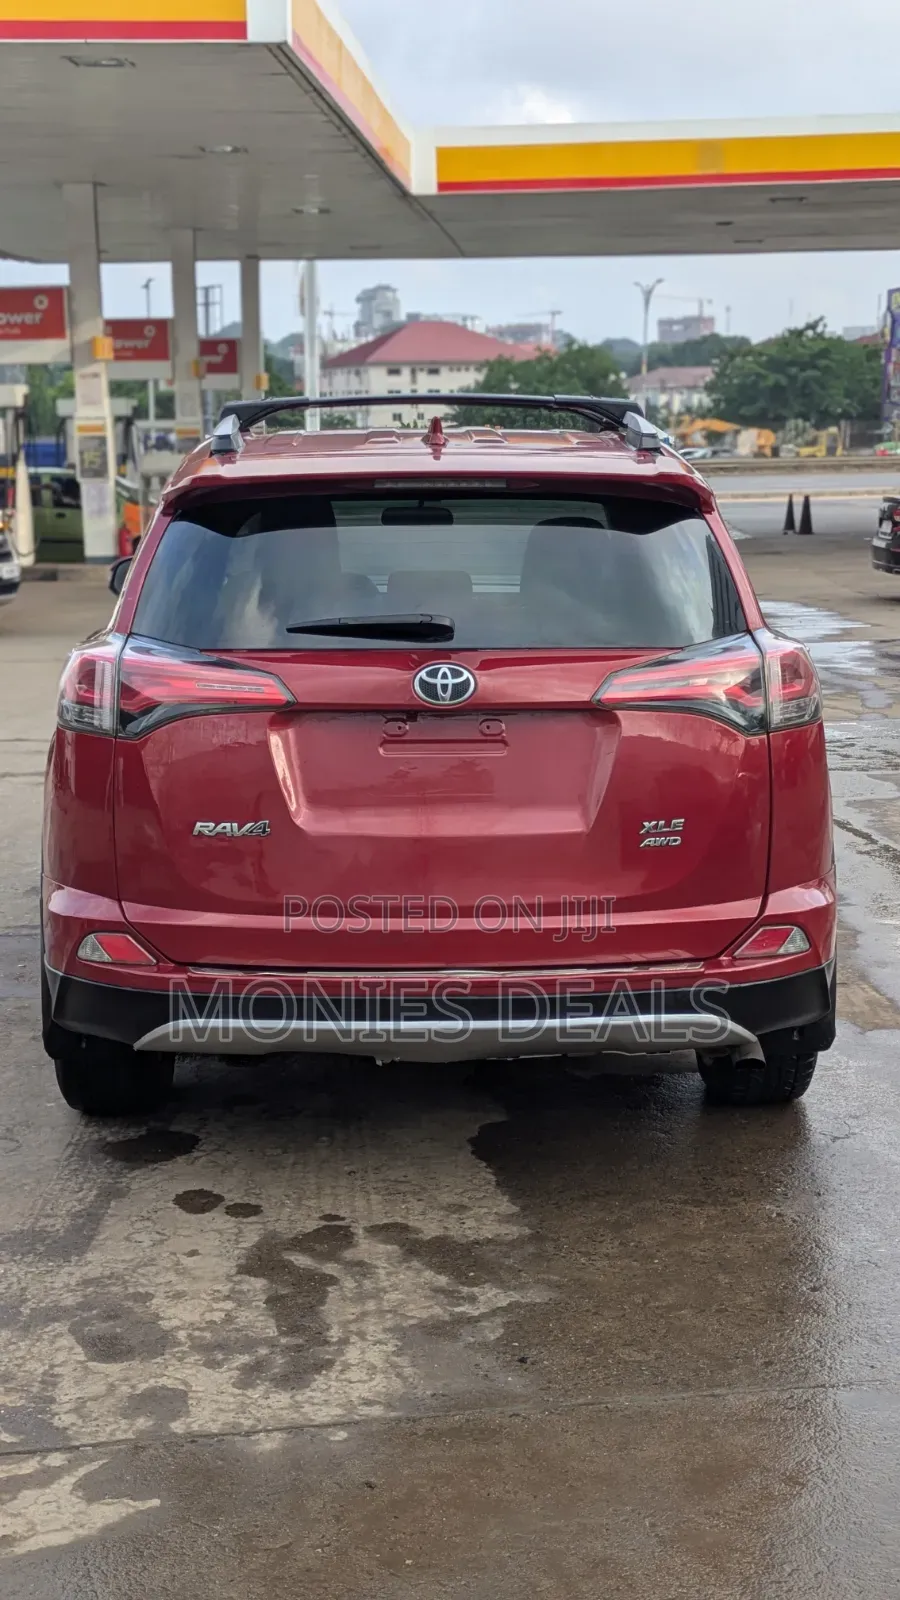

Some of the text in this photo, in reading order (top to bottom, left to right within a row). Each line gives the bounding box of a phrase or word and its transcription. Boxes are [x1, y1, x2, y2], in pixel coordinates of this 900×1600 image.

[192, 820, 270, 836] RAV4
[639, 818, 685, 834] XLE
[639, 836, 682, 848] AWD
